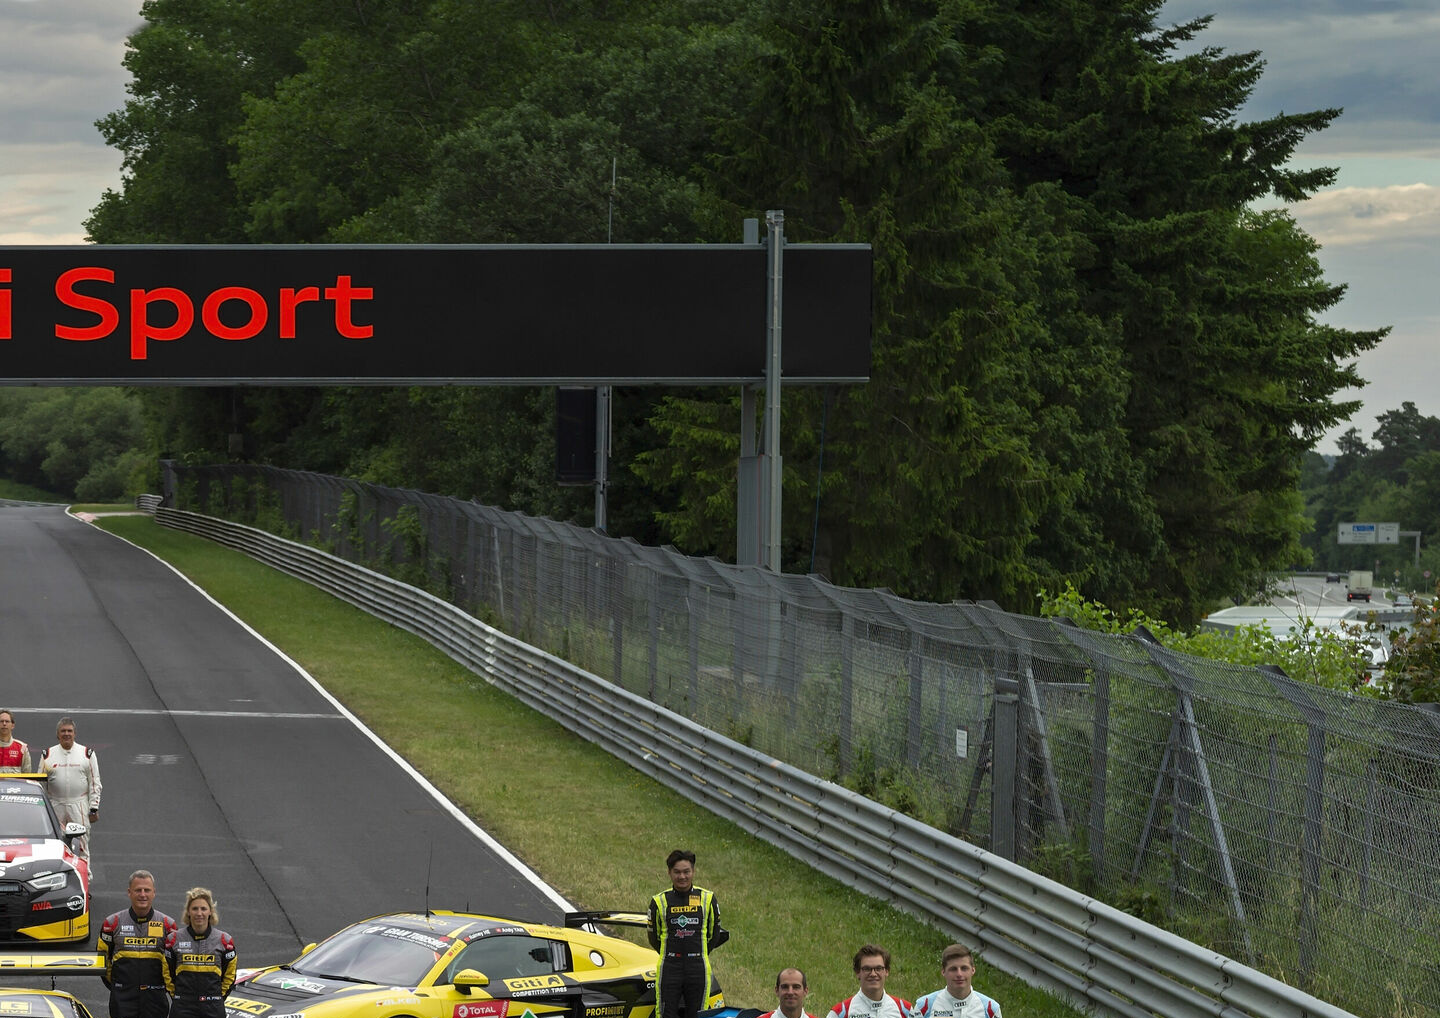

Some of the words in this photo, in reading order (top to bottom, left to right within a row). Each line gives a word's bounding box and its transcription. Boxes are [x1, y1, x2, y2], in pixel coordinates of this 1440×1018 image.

[55, 267, 374, 360] Sport
[32, 902, 52, 911] AVIA
[385, 927, 408, 937] GRAN
[509, 978, 541, 989] Giti
[512, 987, 550, 997] COMPETITION
[469, 1006, 497, 1015] TOTAL
